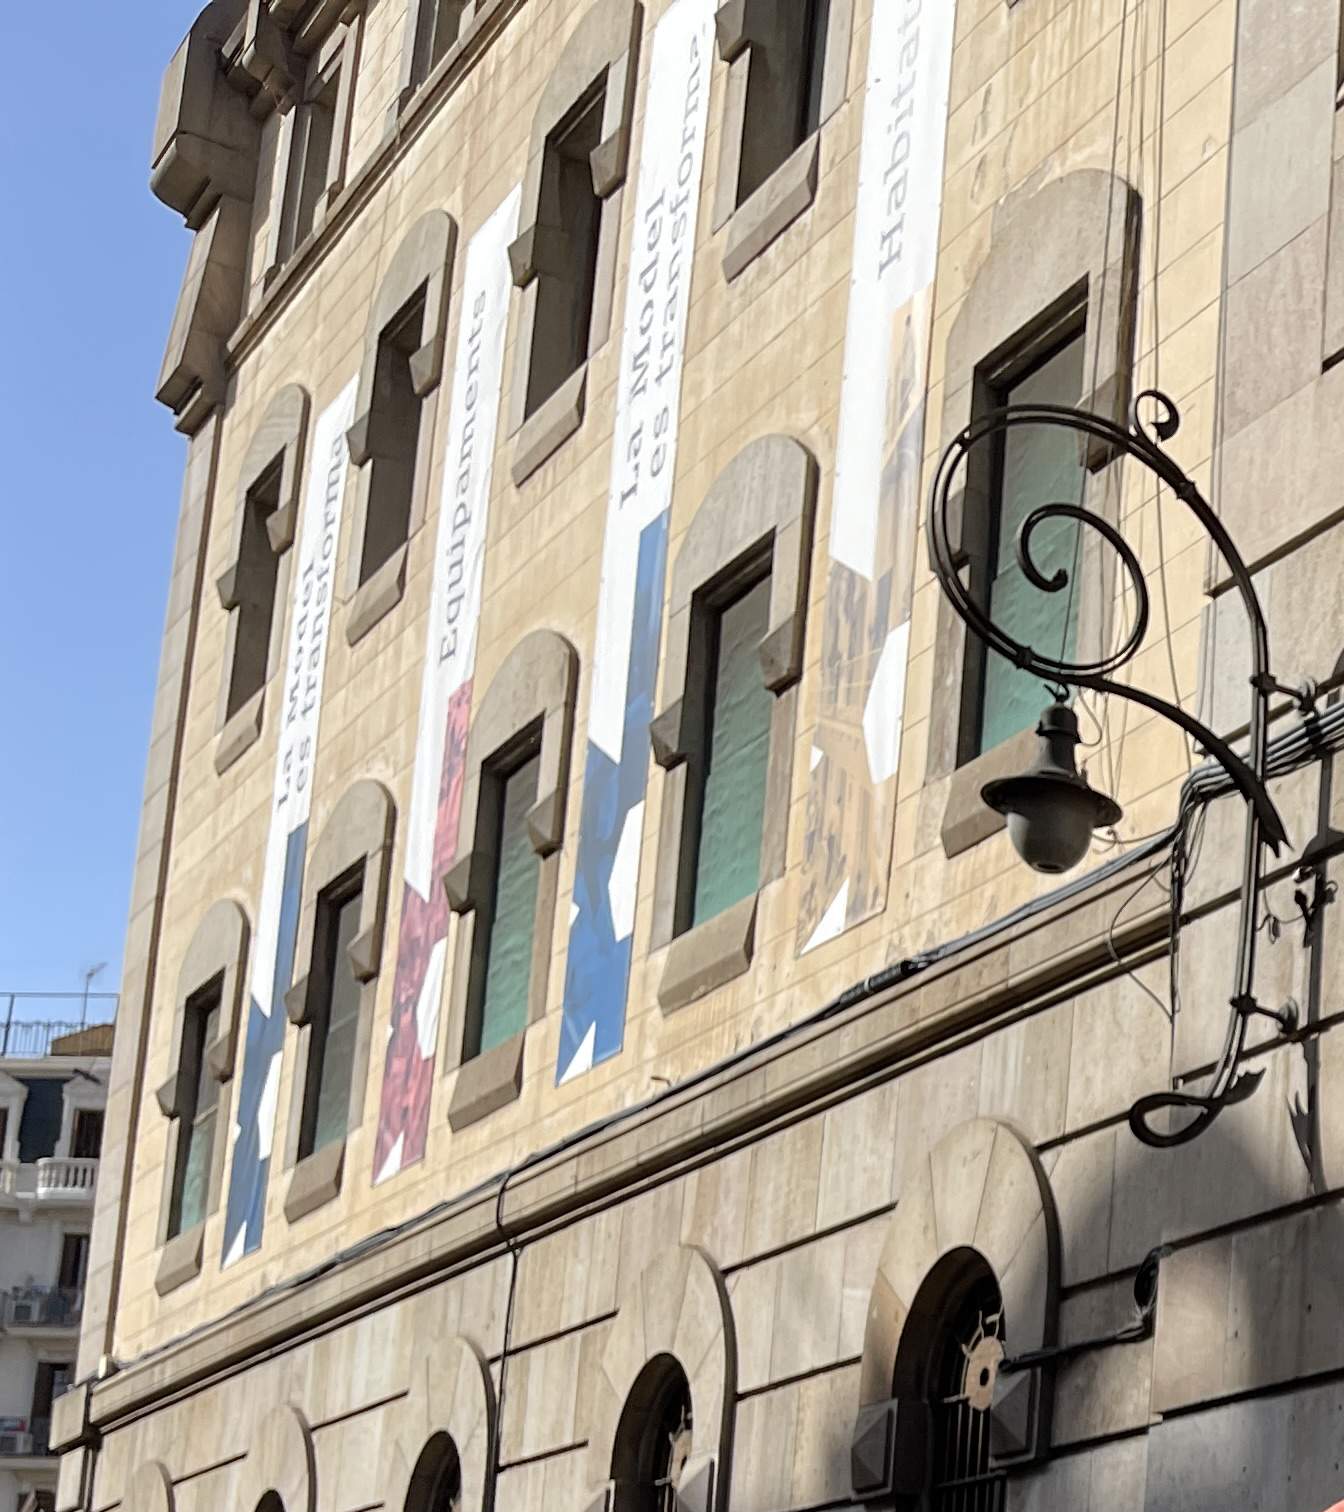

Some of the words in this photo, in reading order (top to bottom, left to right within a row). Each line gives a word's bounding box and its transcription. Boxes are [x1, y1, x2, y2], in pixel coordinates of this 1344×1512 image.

[630, 188, 666, 398] Model
[439, 290, 486, 666] Equipaments
[620, 419, 643, 507] La
[650, 406, 669, 478] es
